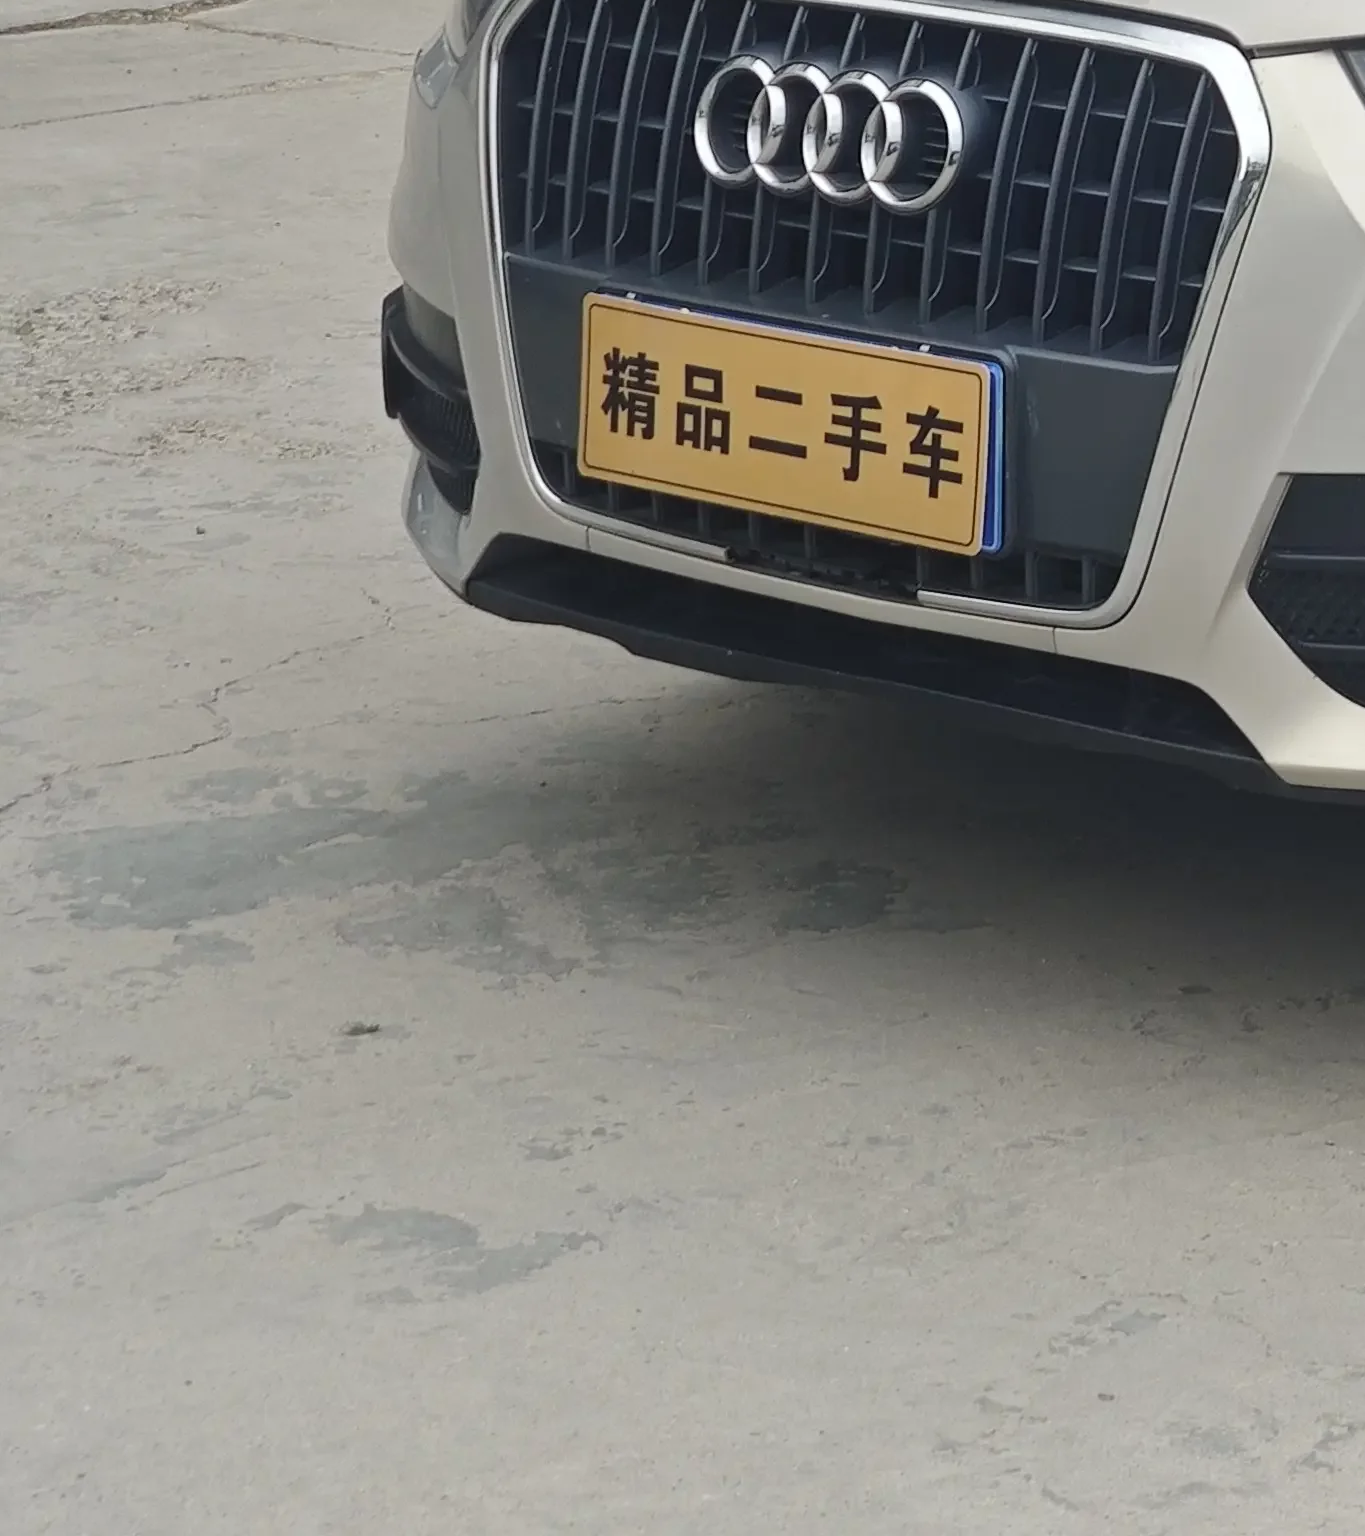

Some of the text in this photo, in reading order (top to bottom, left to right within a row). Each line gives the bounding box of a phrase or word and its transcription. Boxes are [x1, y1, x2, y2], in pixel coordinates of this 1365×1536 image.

[600, 347, 964, 500] 精品二手车
